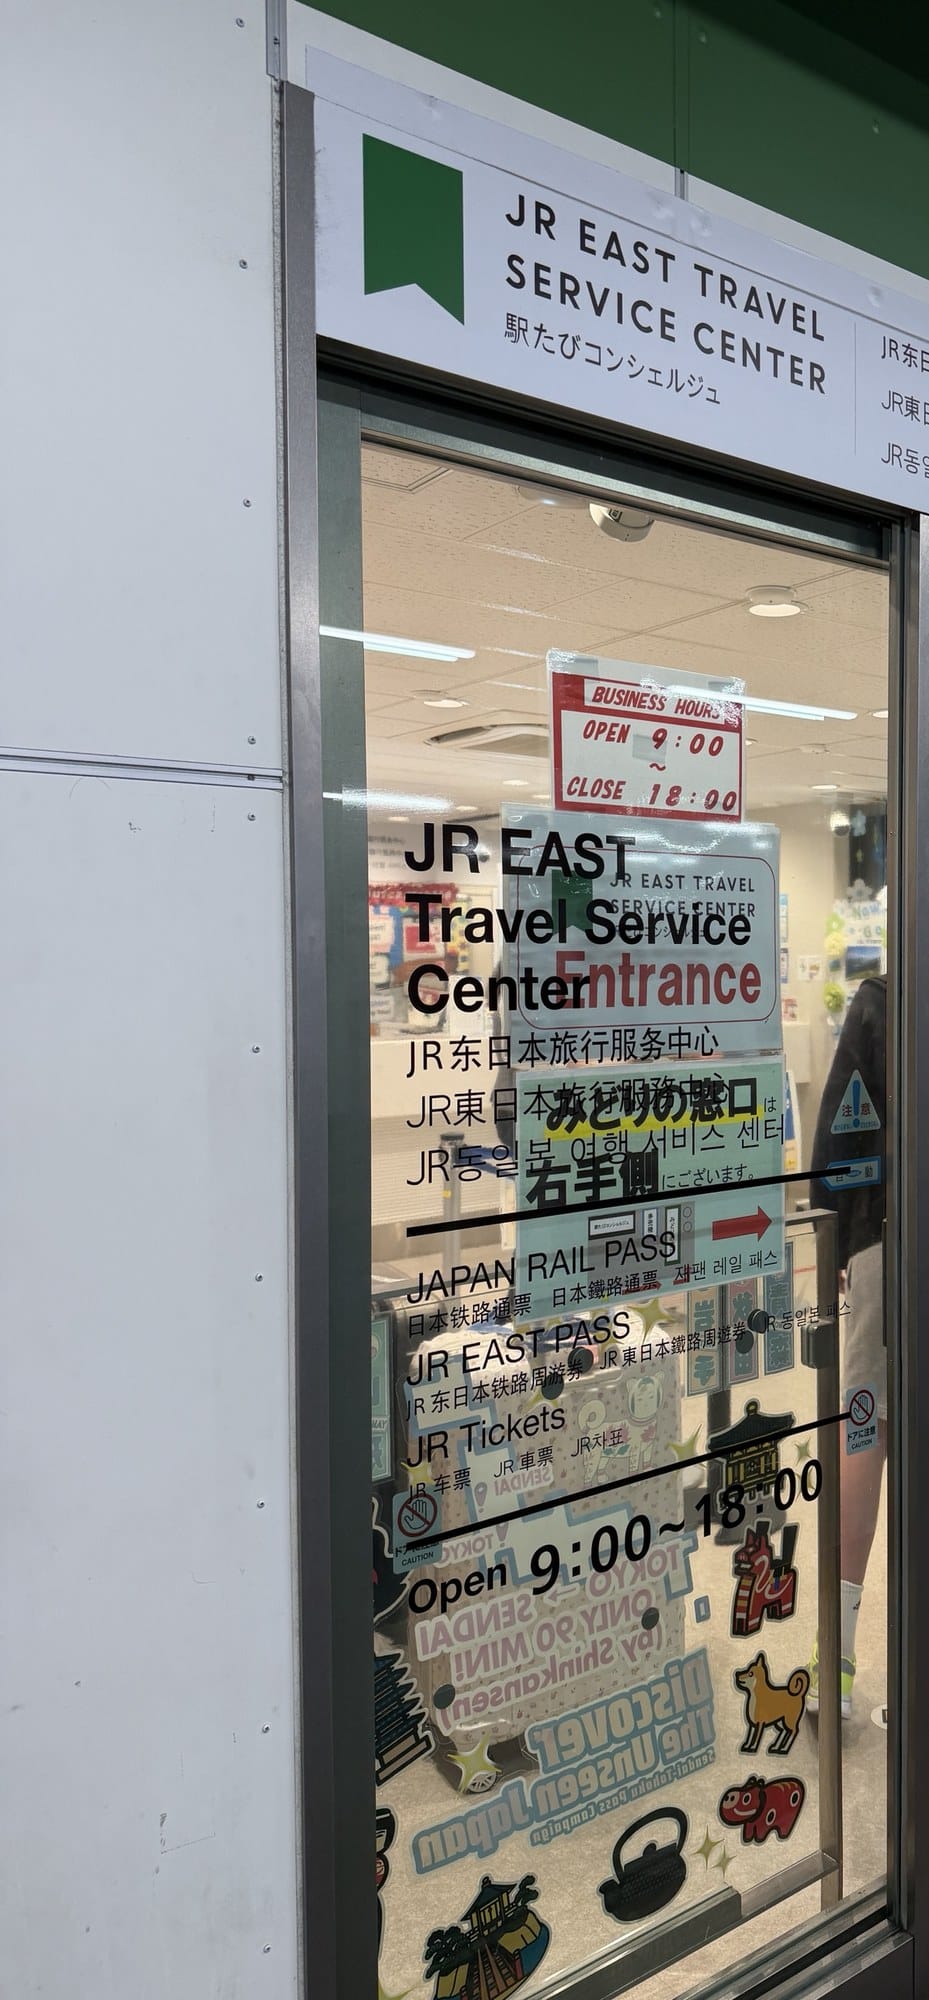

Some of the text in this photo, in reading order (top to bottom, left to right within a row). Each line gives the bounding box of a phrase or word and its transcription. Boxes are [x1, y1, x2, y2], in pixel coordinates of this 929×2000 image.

[505, 194, 825, 342] JR EAST TRAVEL
[505, 254, 826, 394] SERVICE CENTER
[504, 312, 721, 405] 駅たびコンシェルジュ
[592, 686, 721, 719] BUSINESS HOURS
[583, 719, 724, 757] OPEN 9:00
[567, 776, 737, 812] CLOSE 18:00
[404, 823, 636, 880] JR EAST
[610, 872, 755, 892] JR EAST TRAVEL
[611, 899, 756, 917] SERVICE CENTER
[405, 893, 566, 944] Travel
[585, 898, 752, 945] Service
[407, 963, 590, 1014] Center
[555, 950, 761, 1010] Entrance
[406, 1113, 785, 1186] JR동일본 여행 서비스 센터
[406, 1257, 515, 1304] JAPAN
[528, 1245, 596, 1282] RAIL
[605, 1231, 676, 1268] PASS
[408, 1250, 778, 1339] 日本铁路通票 日本鐵路通票 재팬 레일 패스
[781, 1305, 820, 1330] 동일본
[406, 1312, 630, 1386] JR EAST PASS
[406, 1407, 566, 1468] JR Tickets
[851, 1438, 873, 1450] CAUTION
[401, 1551, 434, 1567] CAUTION
[408, 1563, 507, 1614] Open
